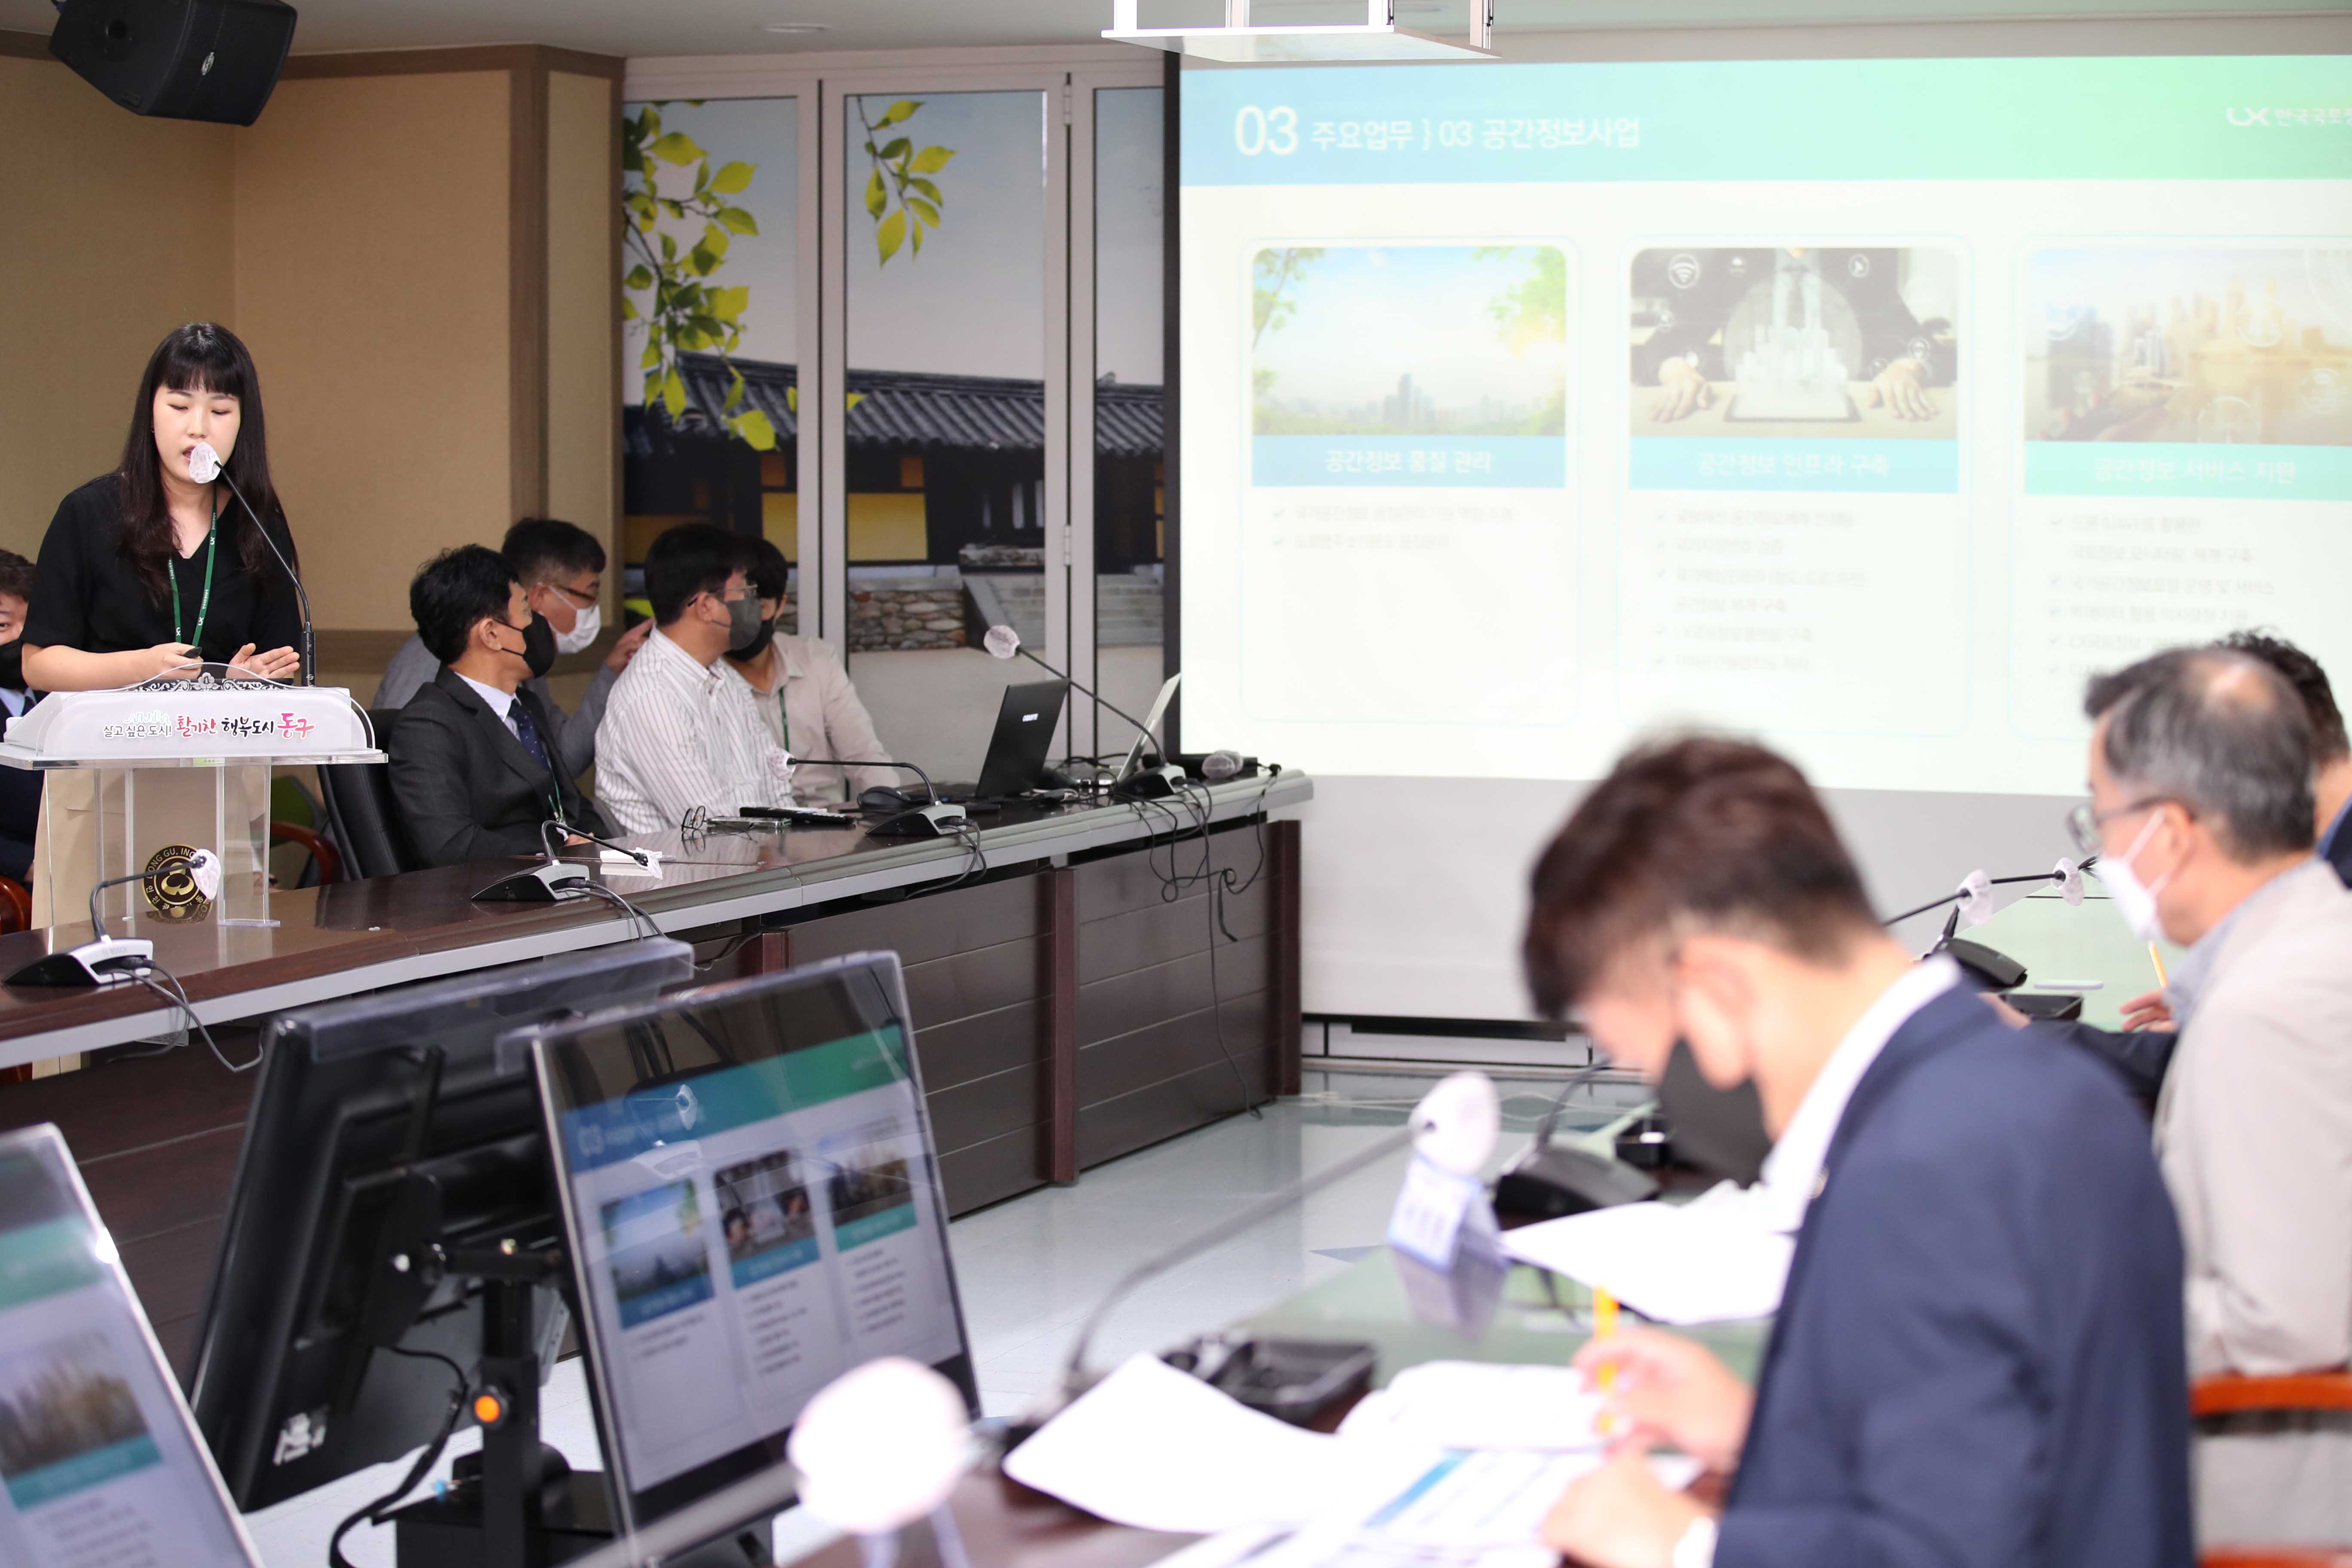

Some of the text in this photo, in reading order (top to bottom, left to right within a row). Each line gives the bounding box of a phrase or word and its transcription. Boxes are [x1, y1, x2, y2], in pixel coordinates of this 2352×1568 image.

[1234, 107, 1299, 156] 03
[1311, 120, 1413, 150] 주요업무
[1439, 122, 1473, 147] 03
[1482, 118, 1641, 148] 공간정보사업
[1325, 450, 1402, 474] 공간정보
[1454, 450, 1492, 474] 관리
[1697, 453, 1776, 477] 공간정보
[2094, 457, 2177, 484] 공간정보
[2184, 459, 2247, 483] 서비스
[197, 617, 204, 626] LX
[103, 713, 315, 738] 살고 싶은 도시! 활기찬 행복도시 동구
